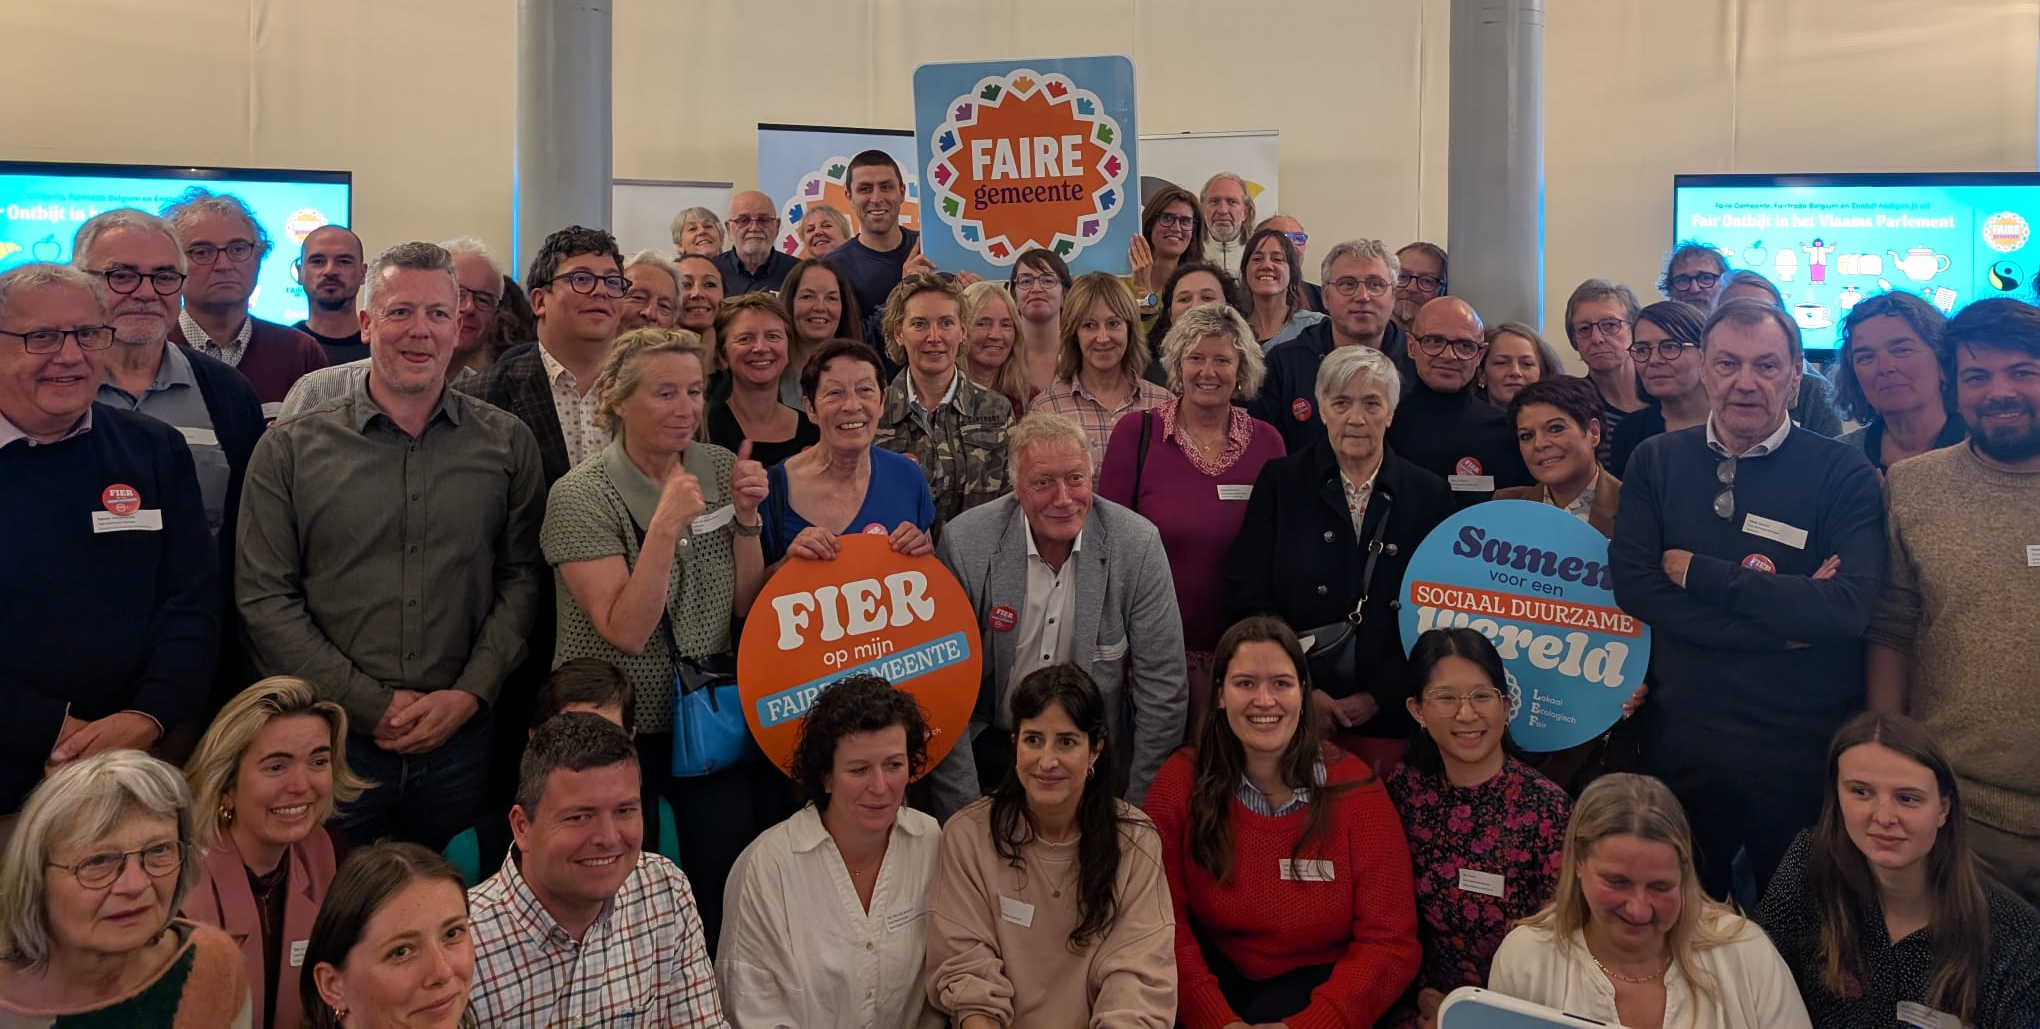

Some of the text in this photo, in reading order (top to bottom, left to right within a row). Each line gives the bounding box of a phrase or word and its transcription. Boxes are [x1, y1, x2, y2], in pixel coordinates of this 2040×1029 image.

[971, 135, 1084, 181] FAIRE
[973, 179, 1084, 211] gemeente
[1774, 202, 1807, 210] Fairtrade
[1809, 202, 1838, 211] Belgium
[7, 204, 66, 223] Ontbijt
[69, 205, 87, 222] in
[1692, 213, 1954, 230] Fair Ontbijt in het Vlaams Parlement
[109, 489, 134, 497] FIER
[1453, 525, 1616, 592] Samen
[1489, 569, 1564, 598] voor een
[771, 570, 935, 650] FIER
[1417, 585, 1635, 634] SOCIAAL DUURZAME
[823, 636, 894, 668] op mijn
[840, 639, 961, 685] MEENTE
[1533, 688, 1563, 706] Lokaal
[1529, 715, 1548, 728] Fair
[1531, 702, 1577, 724] Ecologisch
